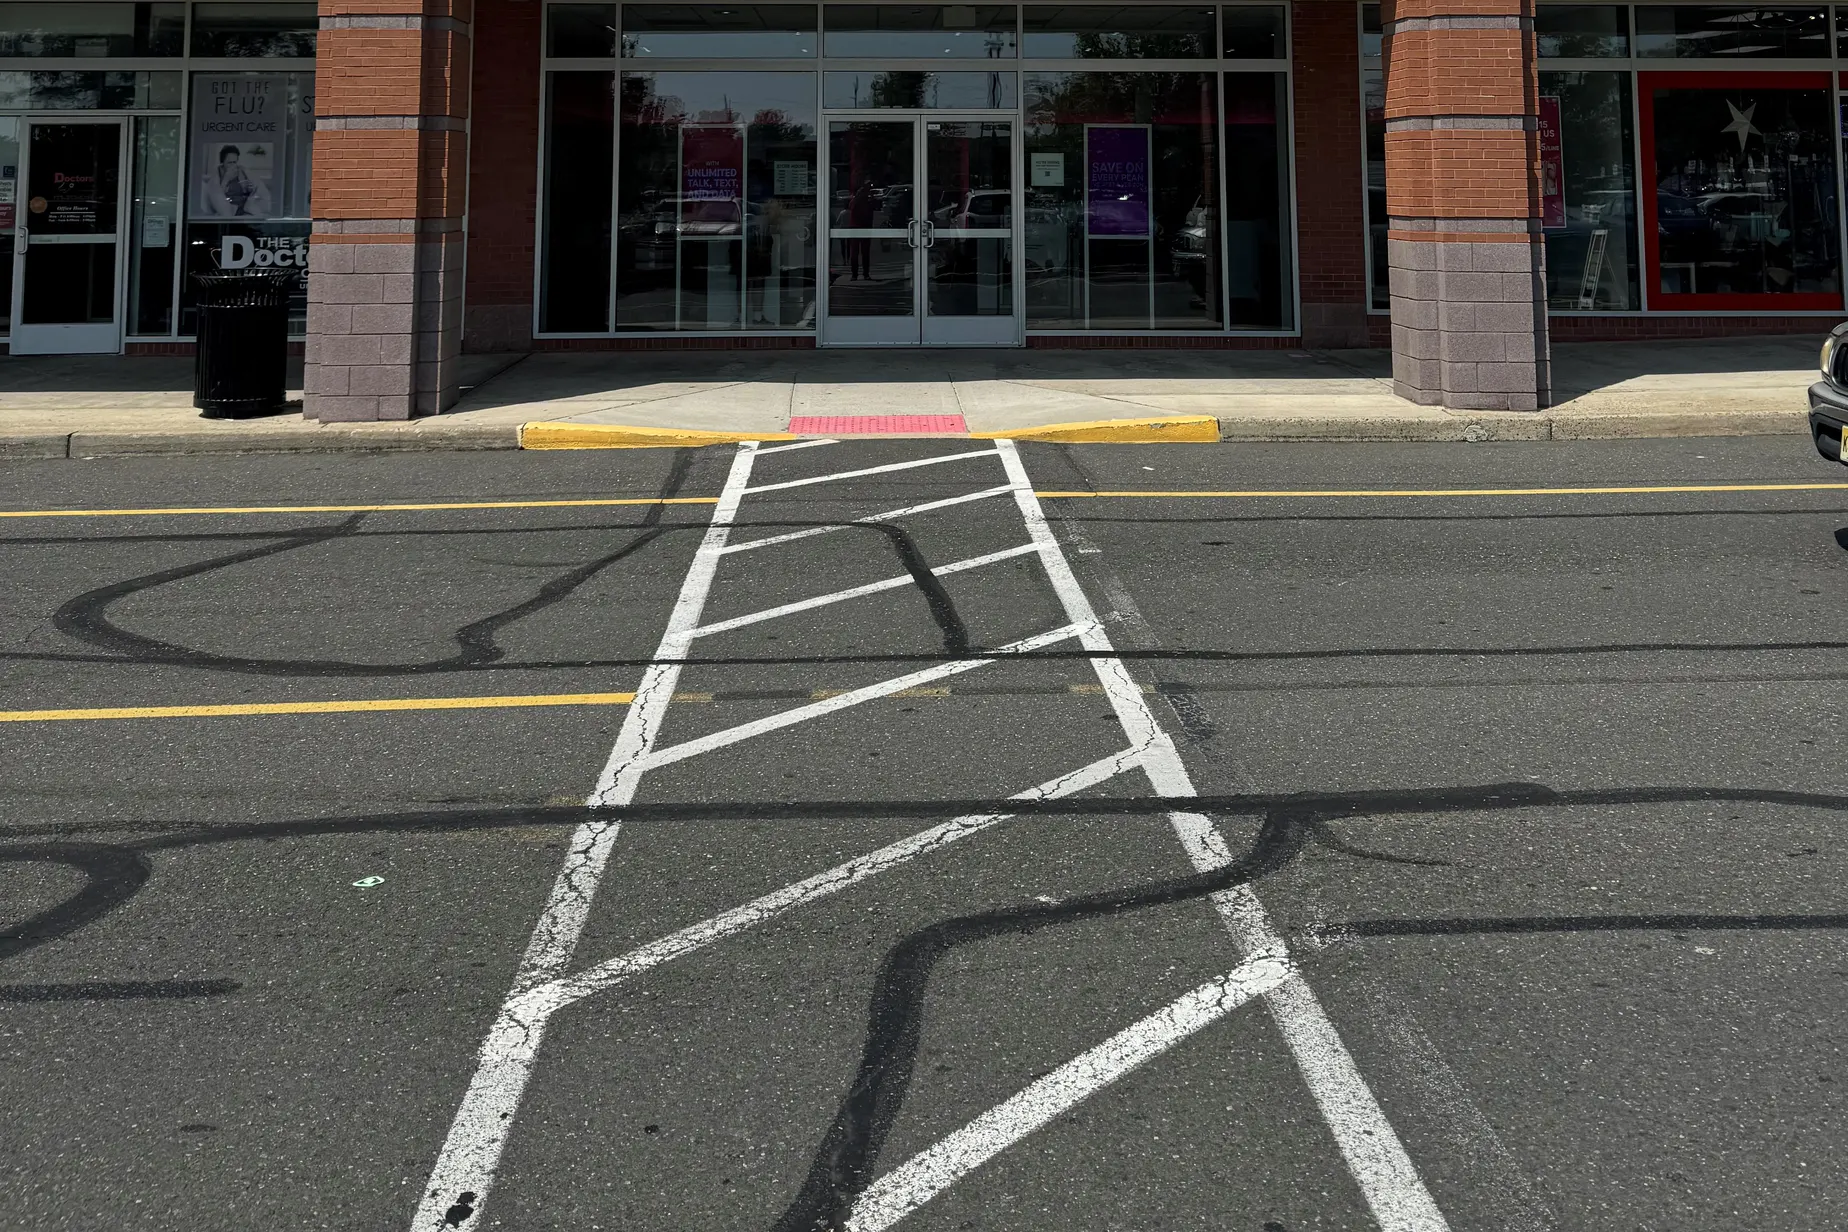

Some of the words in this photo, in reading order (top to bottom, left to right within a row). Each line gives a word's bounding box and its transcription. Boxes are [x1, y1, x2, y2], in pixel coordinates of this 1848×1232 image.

[211, 81, 237, 94] GOT
[246, 81, 271, 94] THE
[214, 96, 265, 114] FLU?
[201, 122, 244, 132] URGENT
[246, 122, 277, 132] CARE
[1543, 129, 1555, 138] US
[1092, 161, 1123, 173] SAVE
[1125, 161, 1144, 173] ON
[687, 168, 737, 177] UNLIMITED
[1092, 173, 1119, 182] EVERY
[687, 179, 712, 189] TALK,
[714, 179, 739, 189] TEXT,
[713, 190, 737, 199] DATA
[256, 237, 290, 248] THE
[220, 235, 310, 270] Doct
